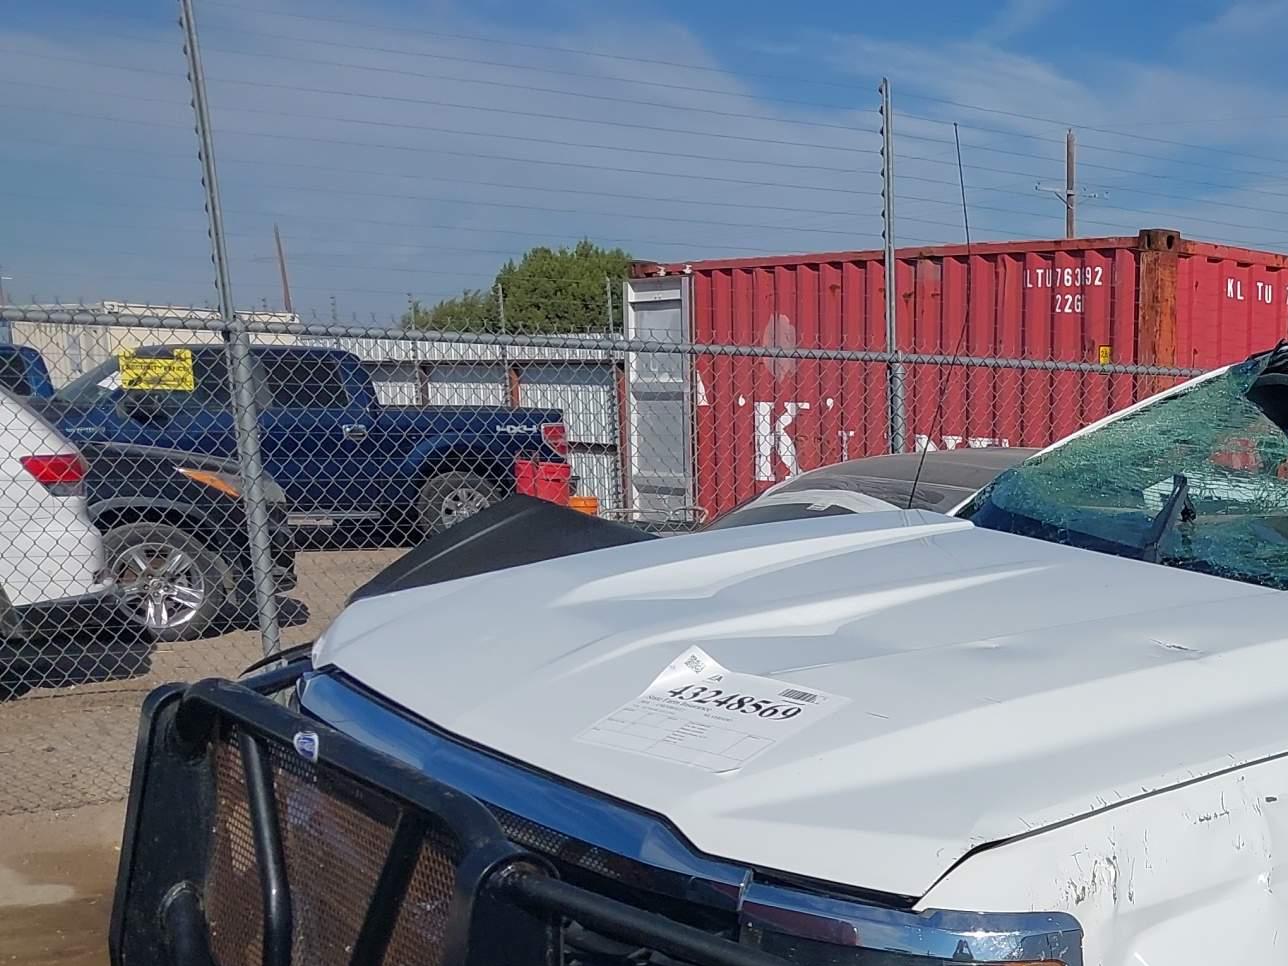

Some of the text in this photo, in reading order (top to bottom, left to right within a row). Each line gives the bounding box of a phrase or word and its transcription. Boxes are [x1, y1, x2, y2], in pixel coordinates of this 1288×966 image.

[1226, 277, 1244, 300] KL
[1256, 281, 1272, 304] TU
[668, 684, 802, 721] 43248569
